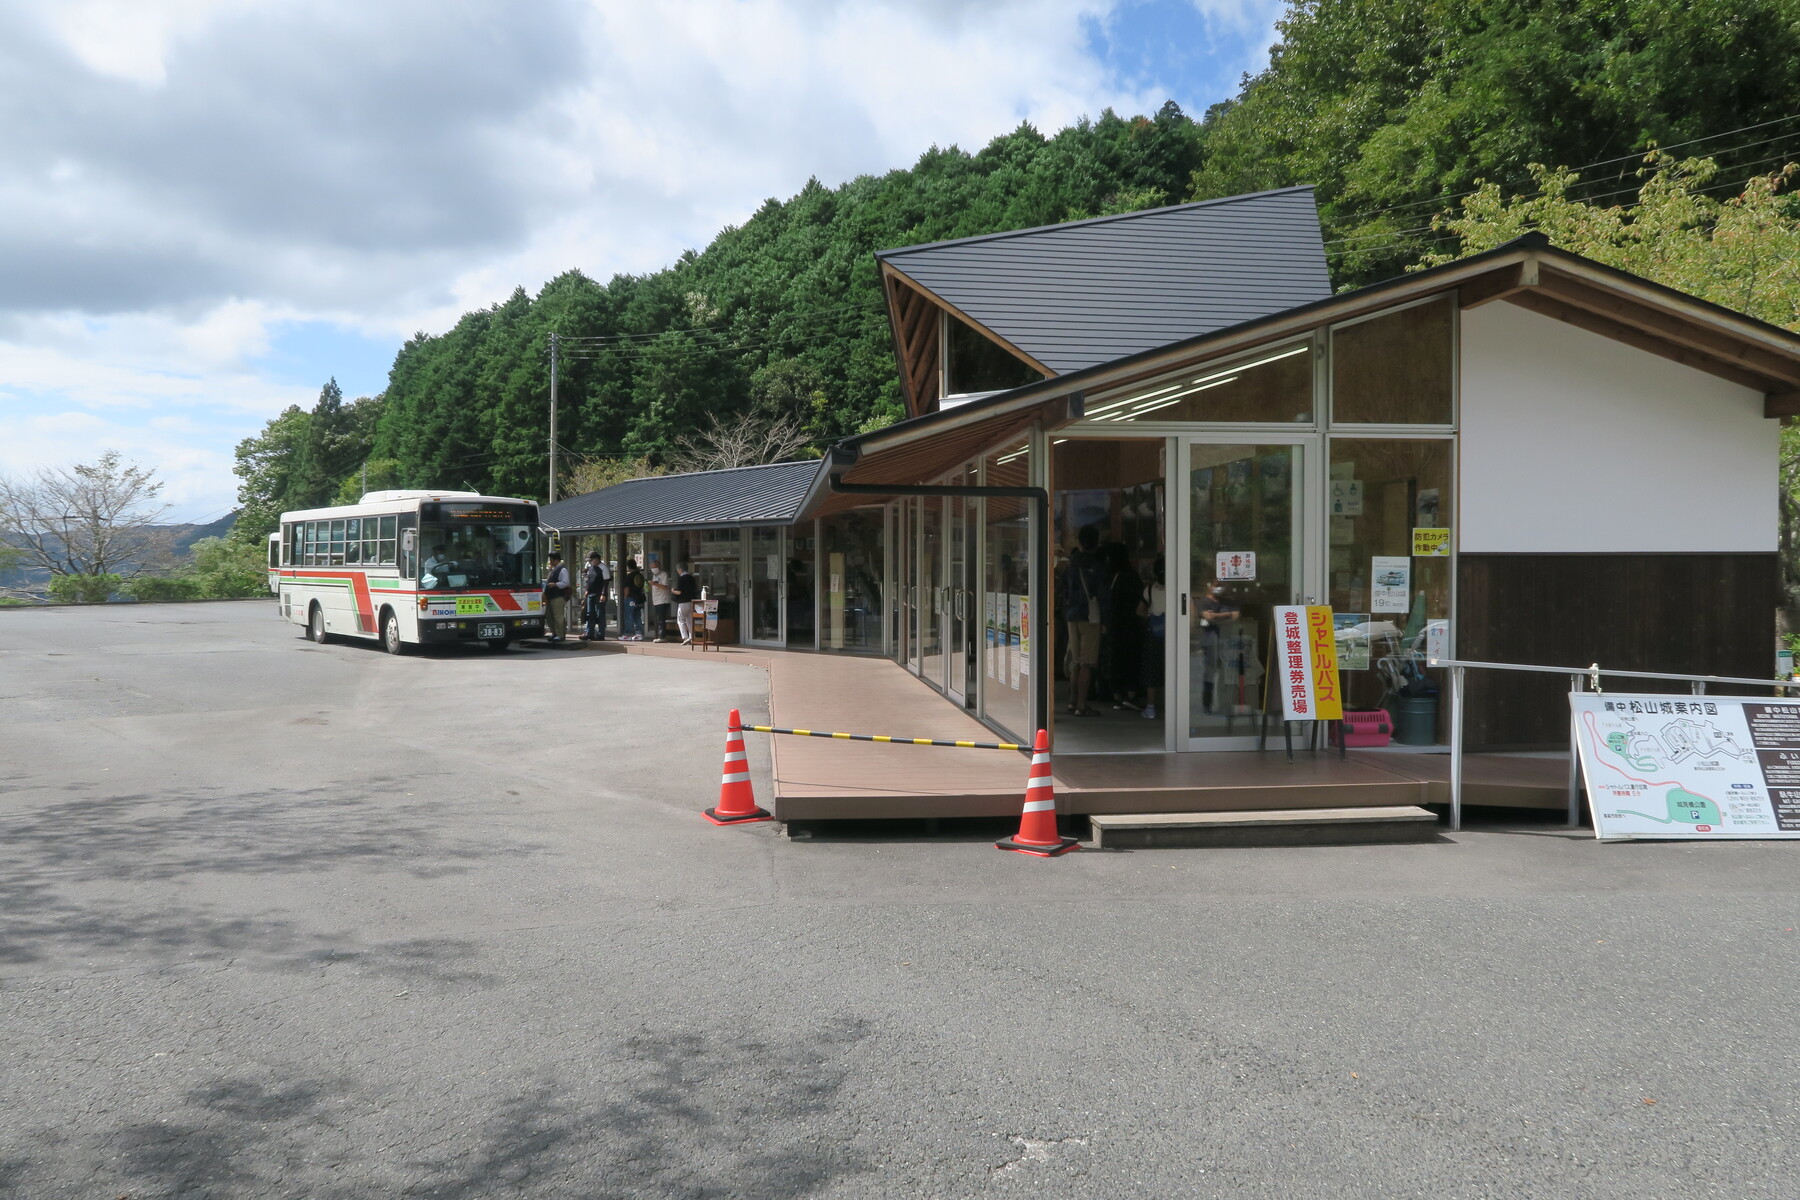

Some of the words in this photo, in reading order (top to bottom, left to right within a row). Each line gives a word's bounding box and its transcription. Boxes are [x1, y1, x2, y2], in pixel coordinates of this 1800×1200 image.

[1415, 532, 1449, 542] 防犯カメラ
[1415, 543, 1438, 552] 作動中
[1284, 611, 1308, 714] 登城整理券売場
[1311, 612, 1336, 702] シャトルバス
[1604, 700, 1718, 716] 備中松山城案内図
